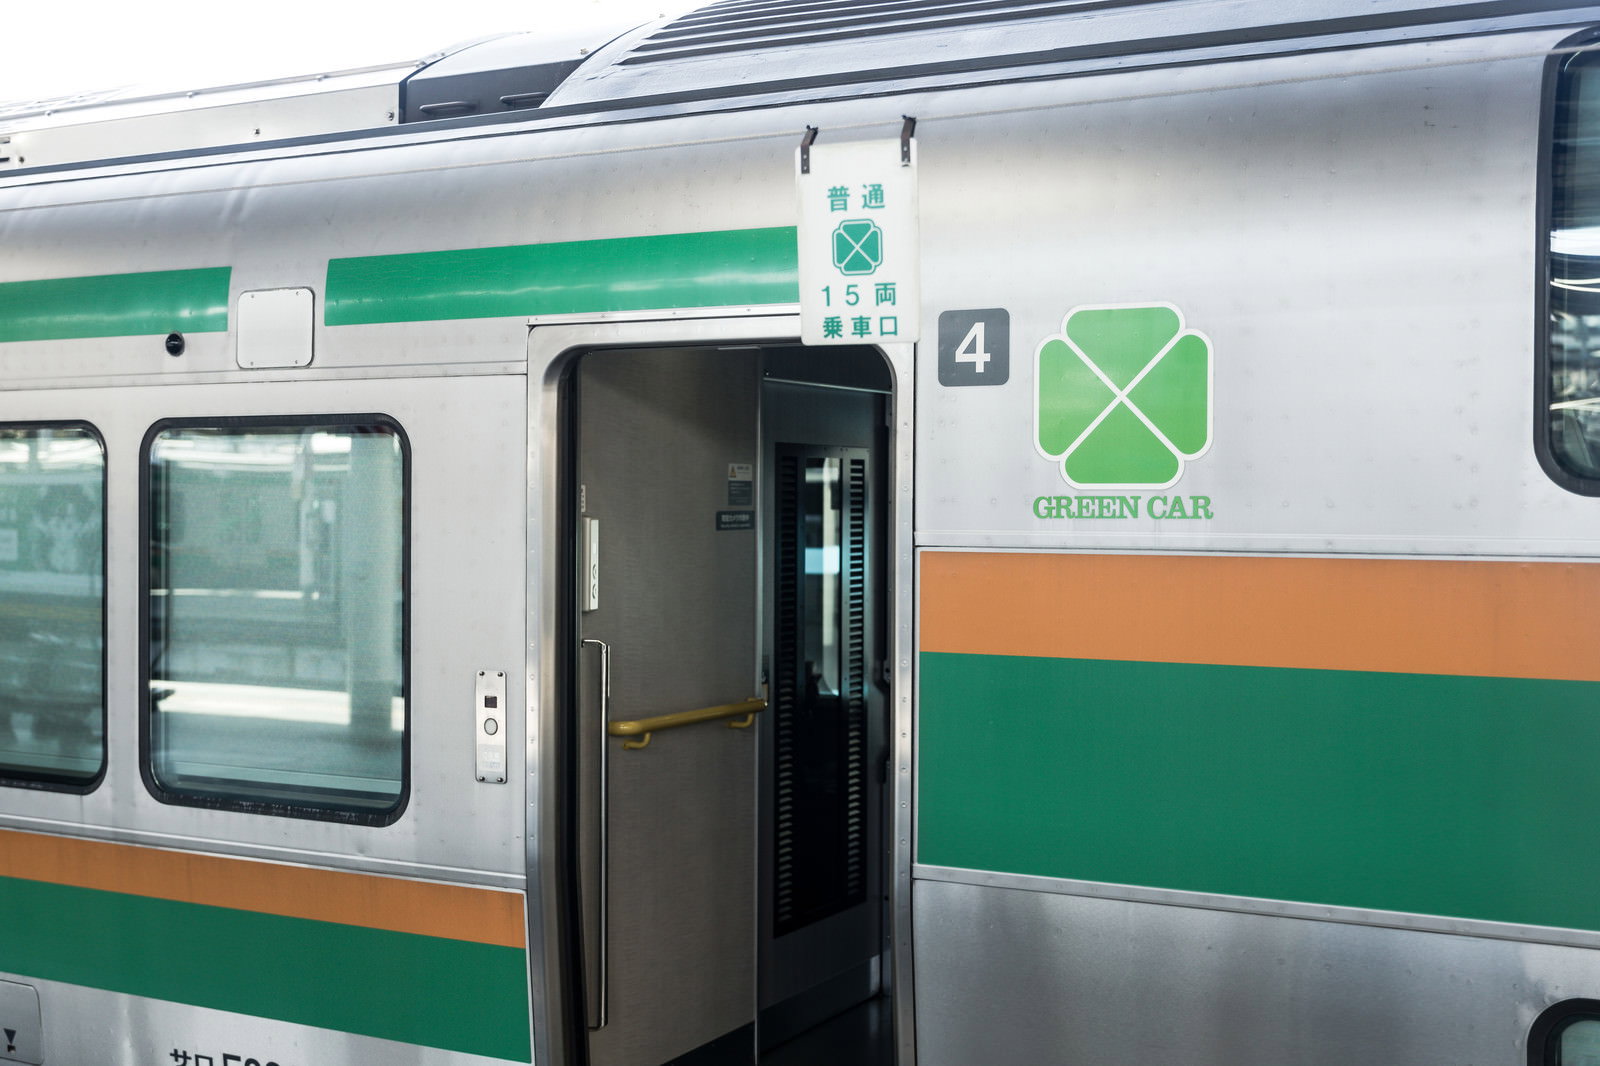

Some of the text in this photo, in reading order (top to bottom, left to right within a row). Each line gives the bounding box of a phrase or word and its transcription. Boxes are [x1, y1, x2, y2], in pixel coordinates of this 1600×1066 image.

[827, 183, 886, 212] 普通
[821, 282, 897, 307] 15両
[823, 315, 898, 338] 乗車口
[954, 321, 991, 373] 4
[1032, 495, 1214, 520] GREEN CAR
